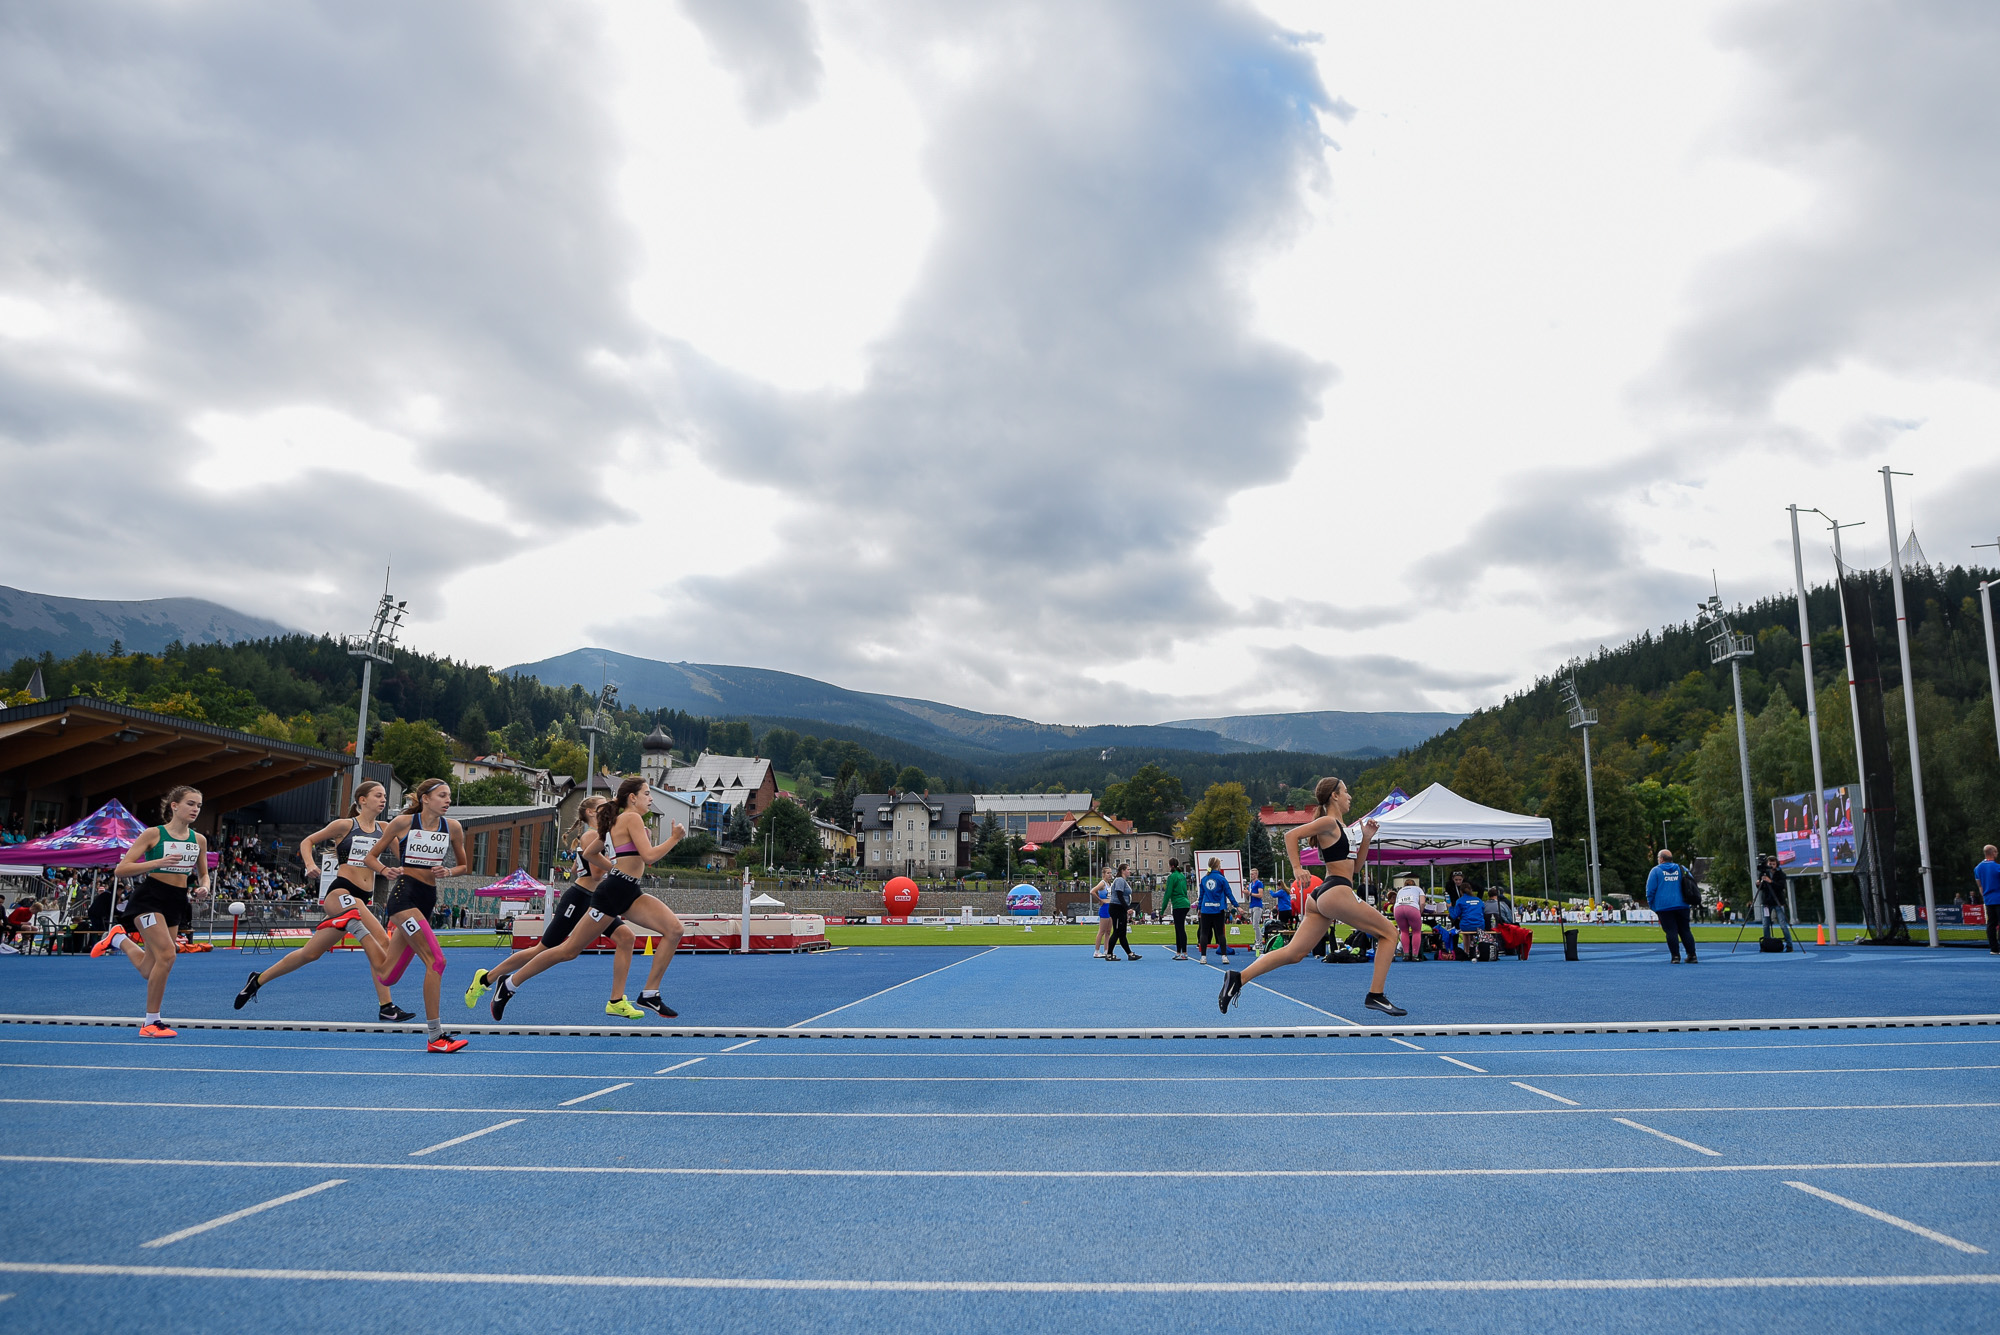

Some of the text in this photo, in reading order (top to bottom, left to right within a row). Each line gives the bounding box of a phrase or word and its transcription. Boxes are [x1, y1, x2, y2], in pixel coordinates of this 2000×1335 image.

[430, 833, 447, 842] 607
[409, 843, 445, 855] KRÓLAK
[342, 895, 352, 906] 5
[142, 914, 151, 926] 7
[405, 920, 416, 932] 6
